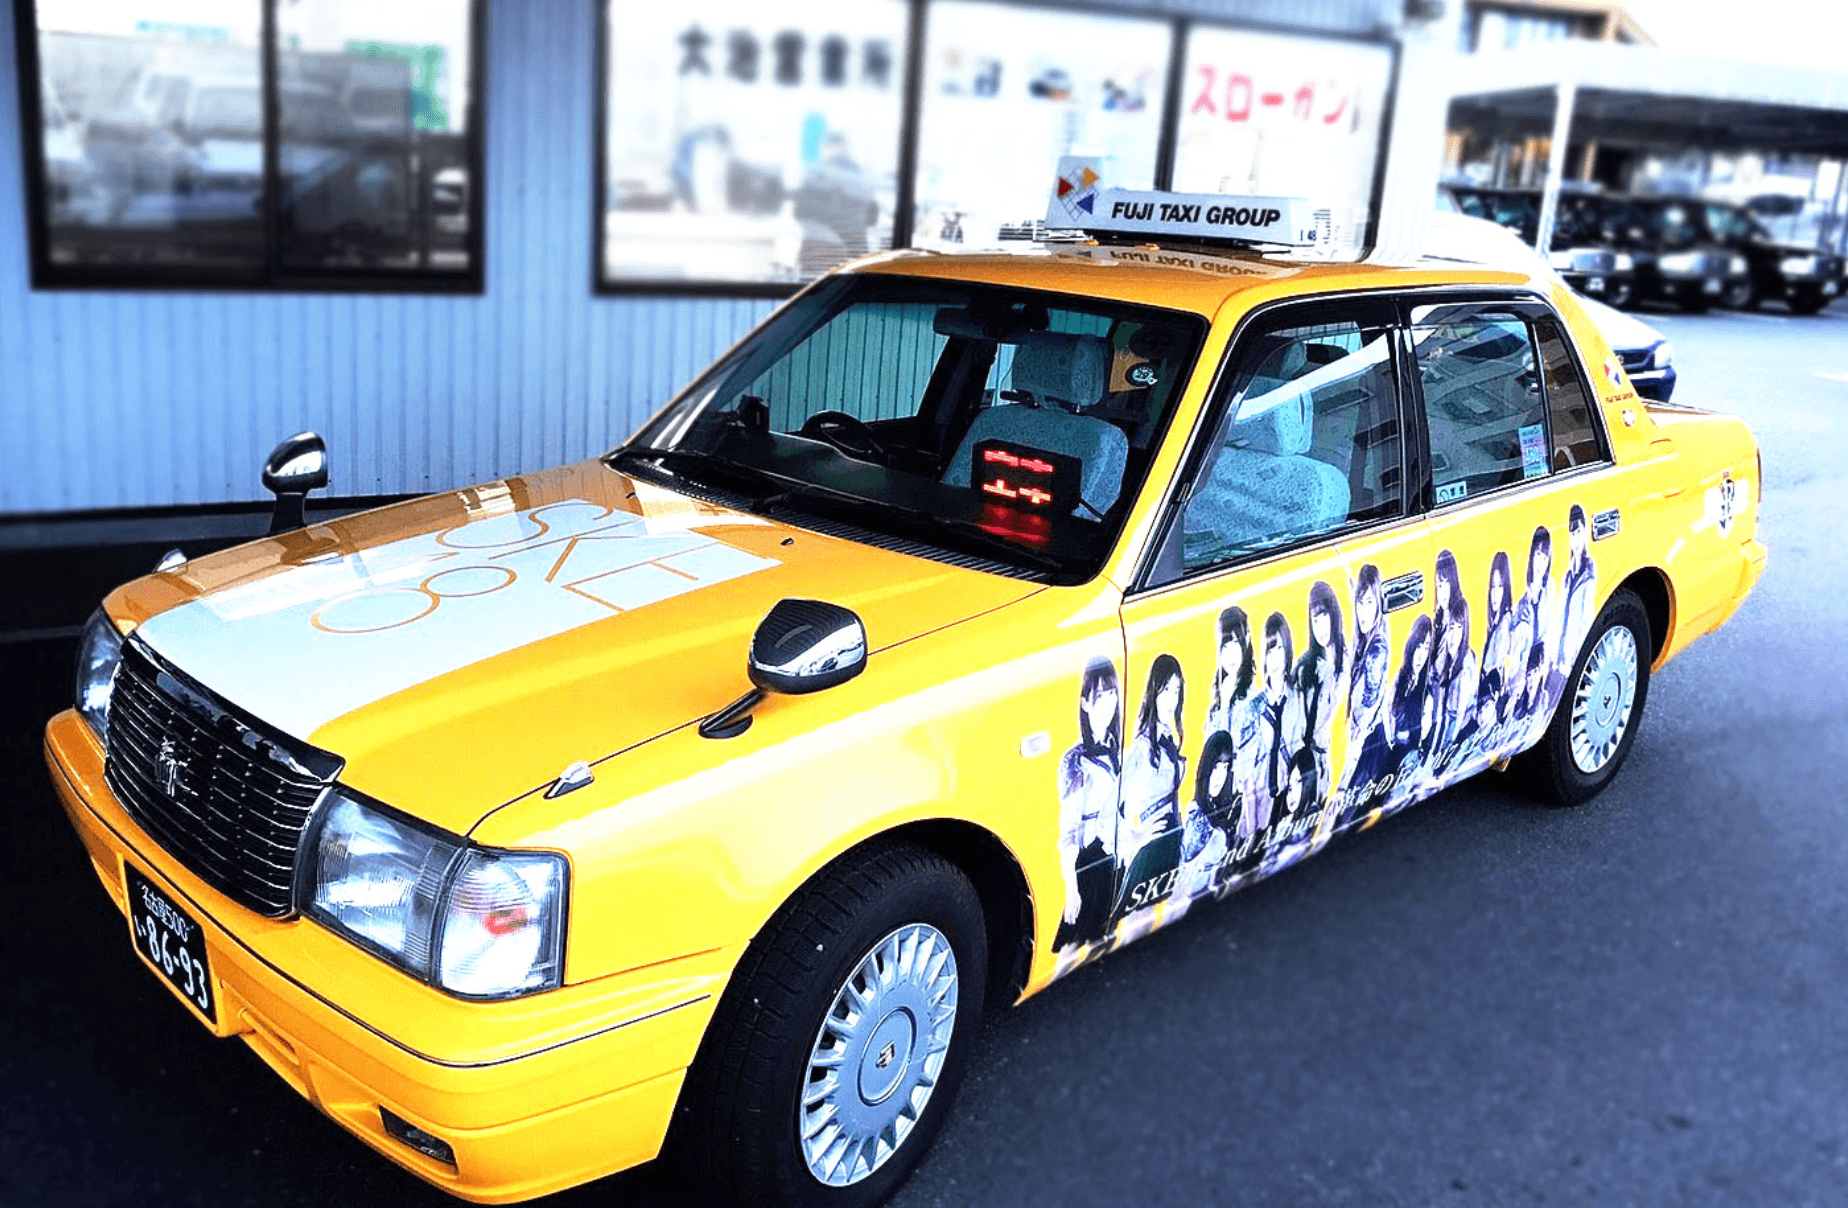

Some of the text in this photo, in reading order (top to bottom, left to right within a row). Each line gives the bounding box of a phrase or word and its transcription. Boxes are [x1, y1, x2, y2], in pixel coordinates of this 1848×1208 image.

[1111, 201, 1281, 228] FUJI TAXI GROUP
[146, 914, 209, 1009] 86-93
